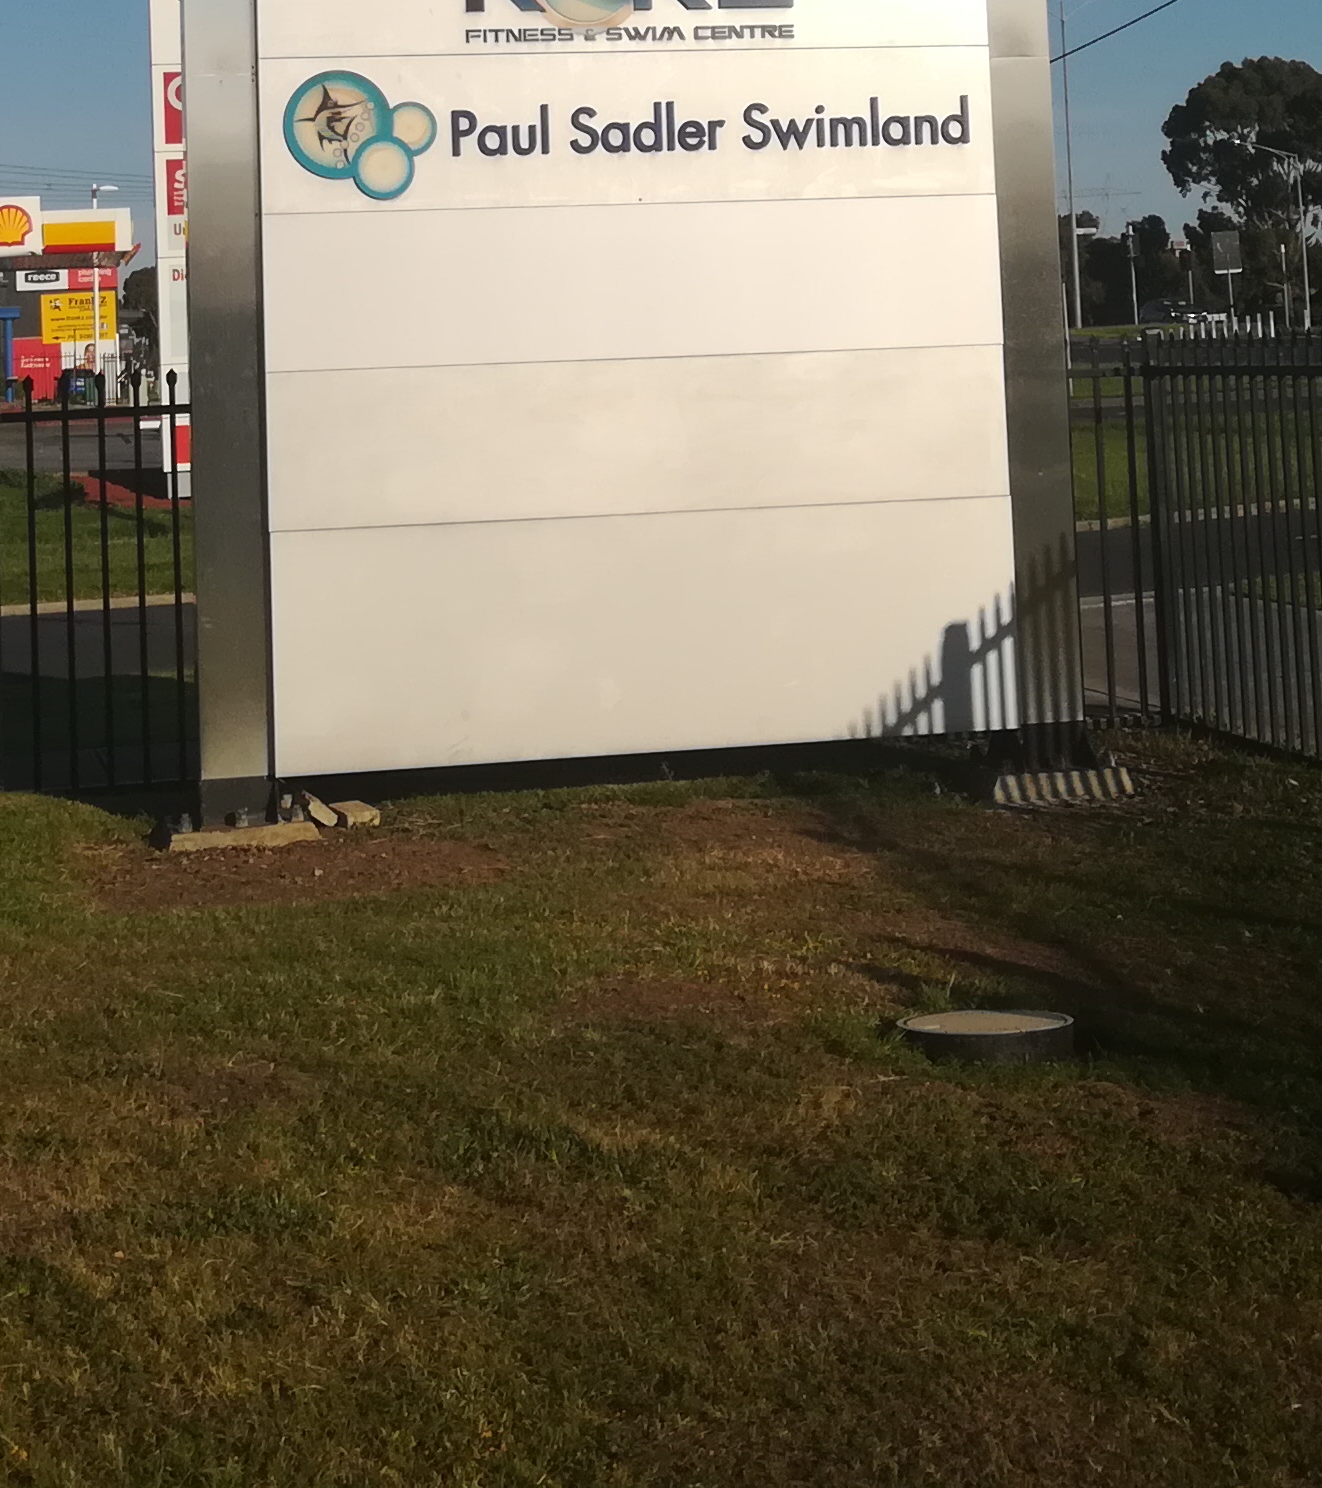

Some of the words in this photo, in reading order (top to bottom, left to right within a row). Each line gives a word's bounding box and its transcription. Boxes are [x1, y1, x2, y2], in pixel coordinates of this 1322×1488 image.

[465, 27, 574, 44] FITNESS
[605, 25, 686, 42] SWIM
[693, 23, 795, 40] CENTRE
[450, 104, 551, 158] Paul
[569, 100, 726, 154] Sadler
[742, 95, 971, 151] Swimland
